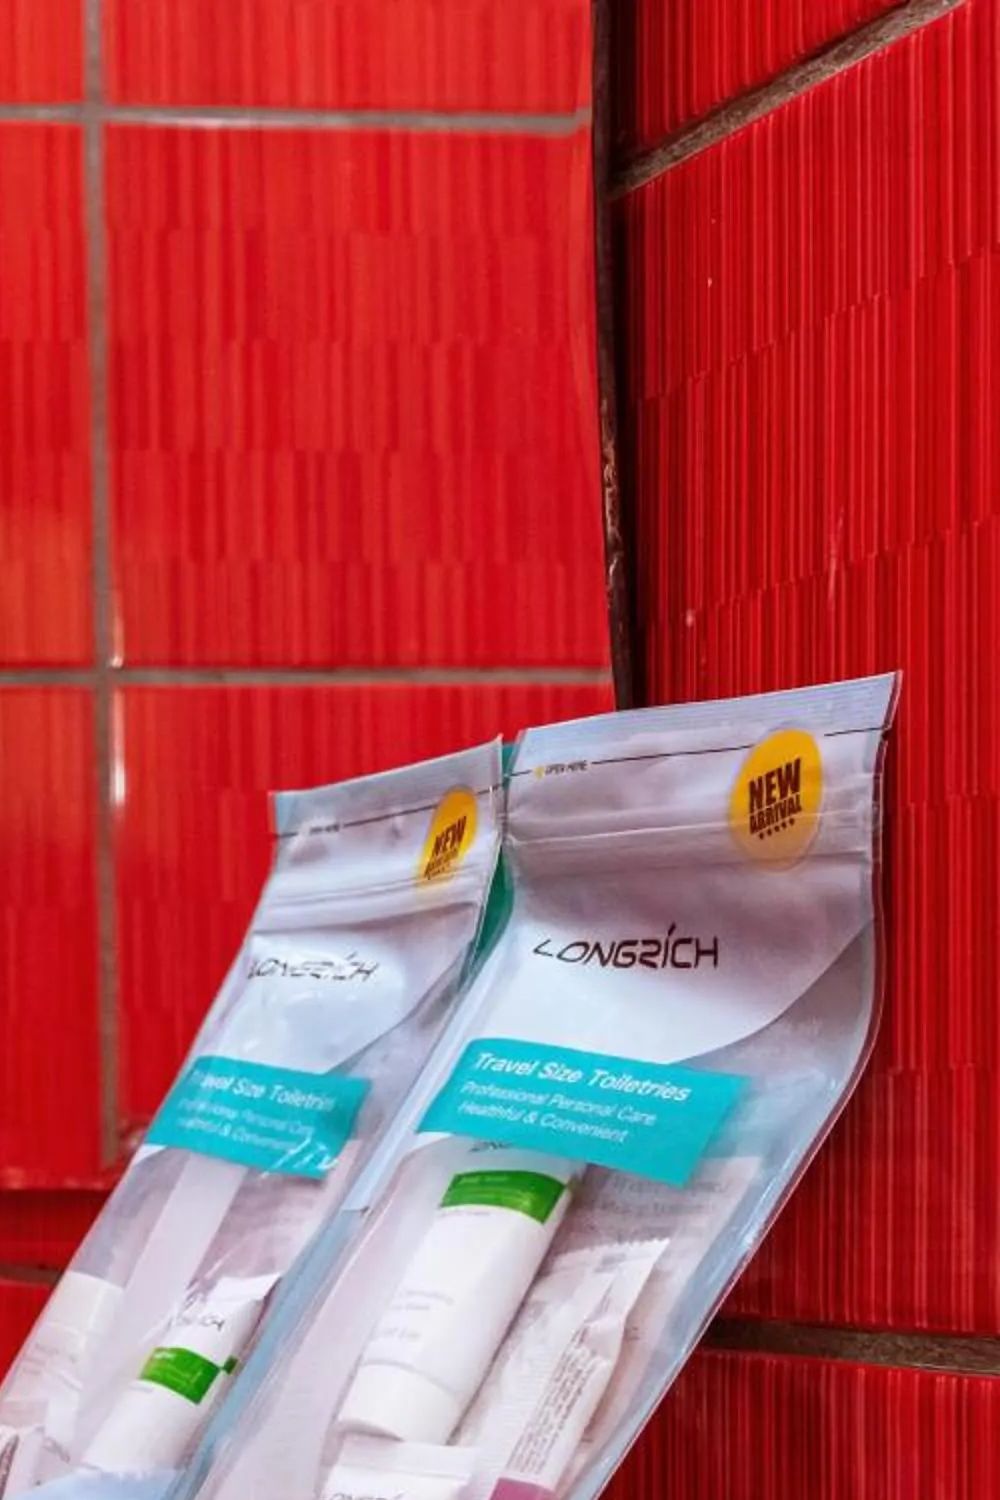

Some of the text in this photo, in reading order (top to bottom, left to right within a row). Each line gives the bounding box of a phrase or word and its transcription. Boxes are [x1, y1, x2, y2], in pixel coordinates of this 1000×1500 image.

[749, 757, 802, 815] NEW
[749, 794, 803, 835] ARRIVAL
[432, 815, 467, 857] NEW
[475, 1052, 693, 1102] Travel Size Toiletries
[522, 1111, 539, 1125] &
[547, 1093, 618, 1119] Personal
[616, 1104, 657, 1127] Care
